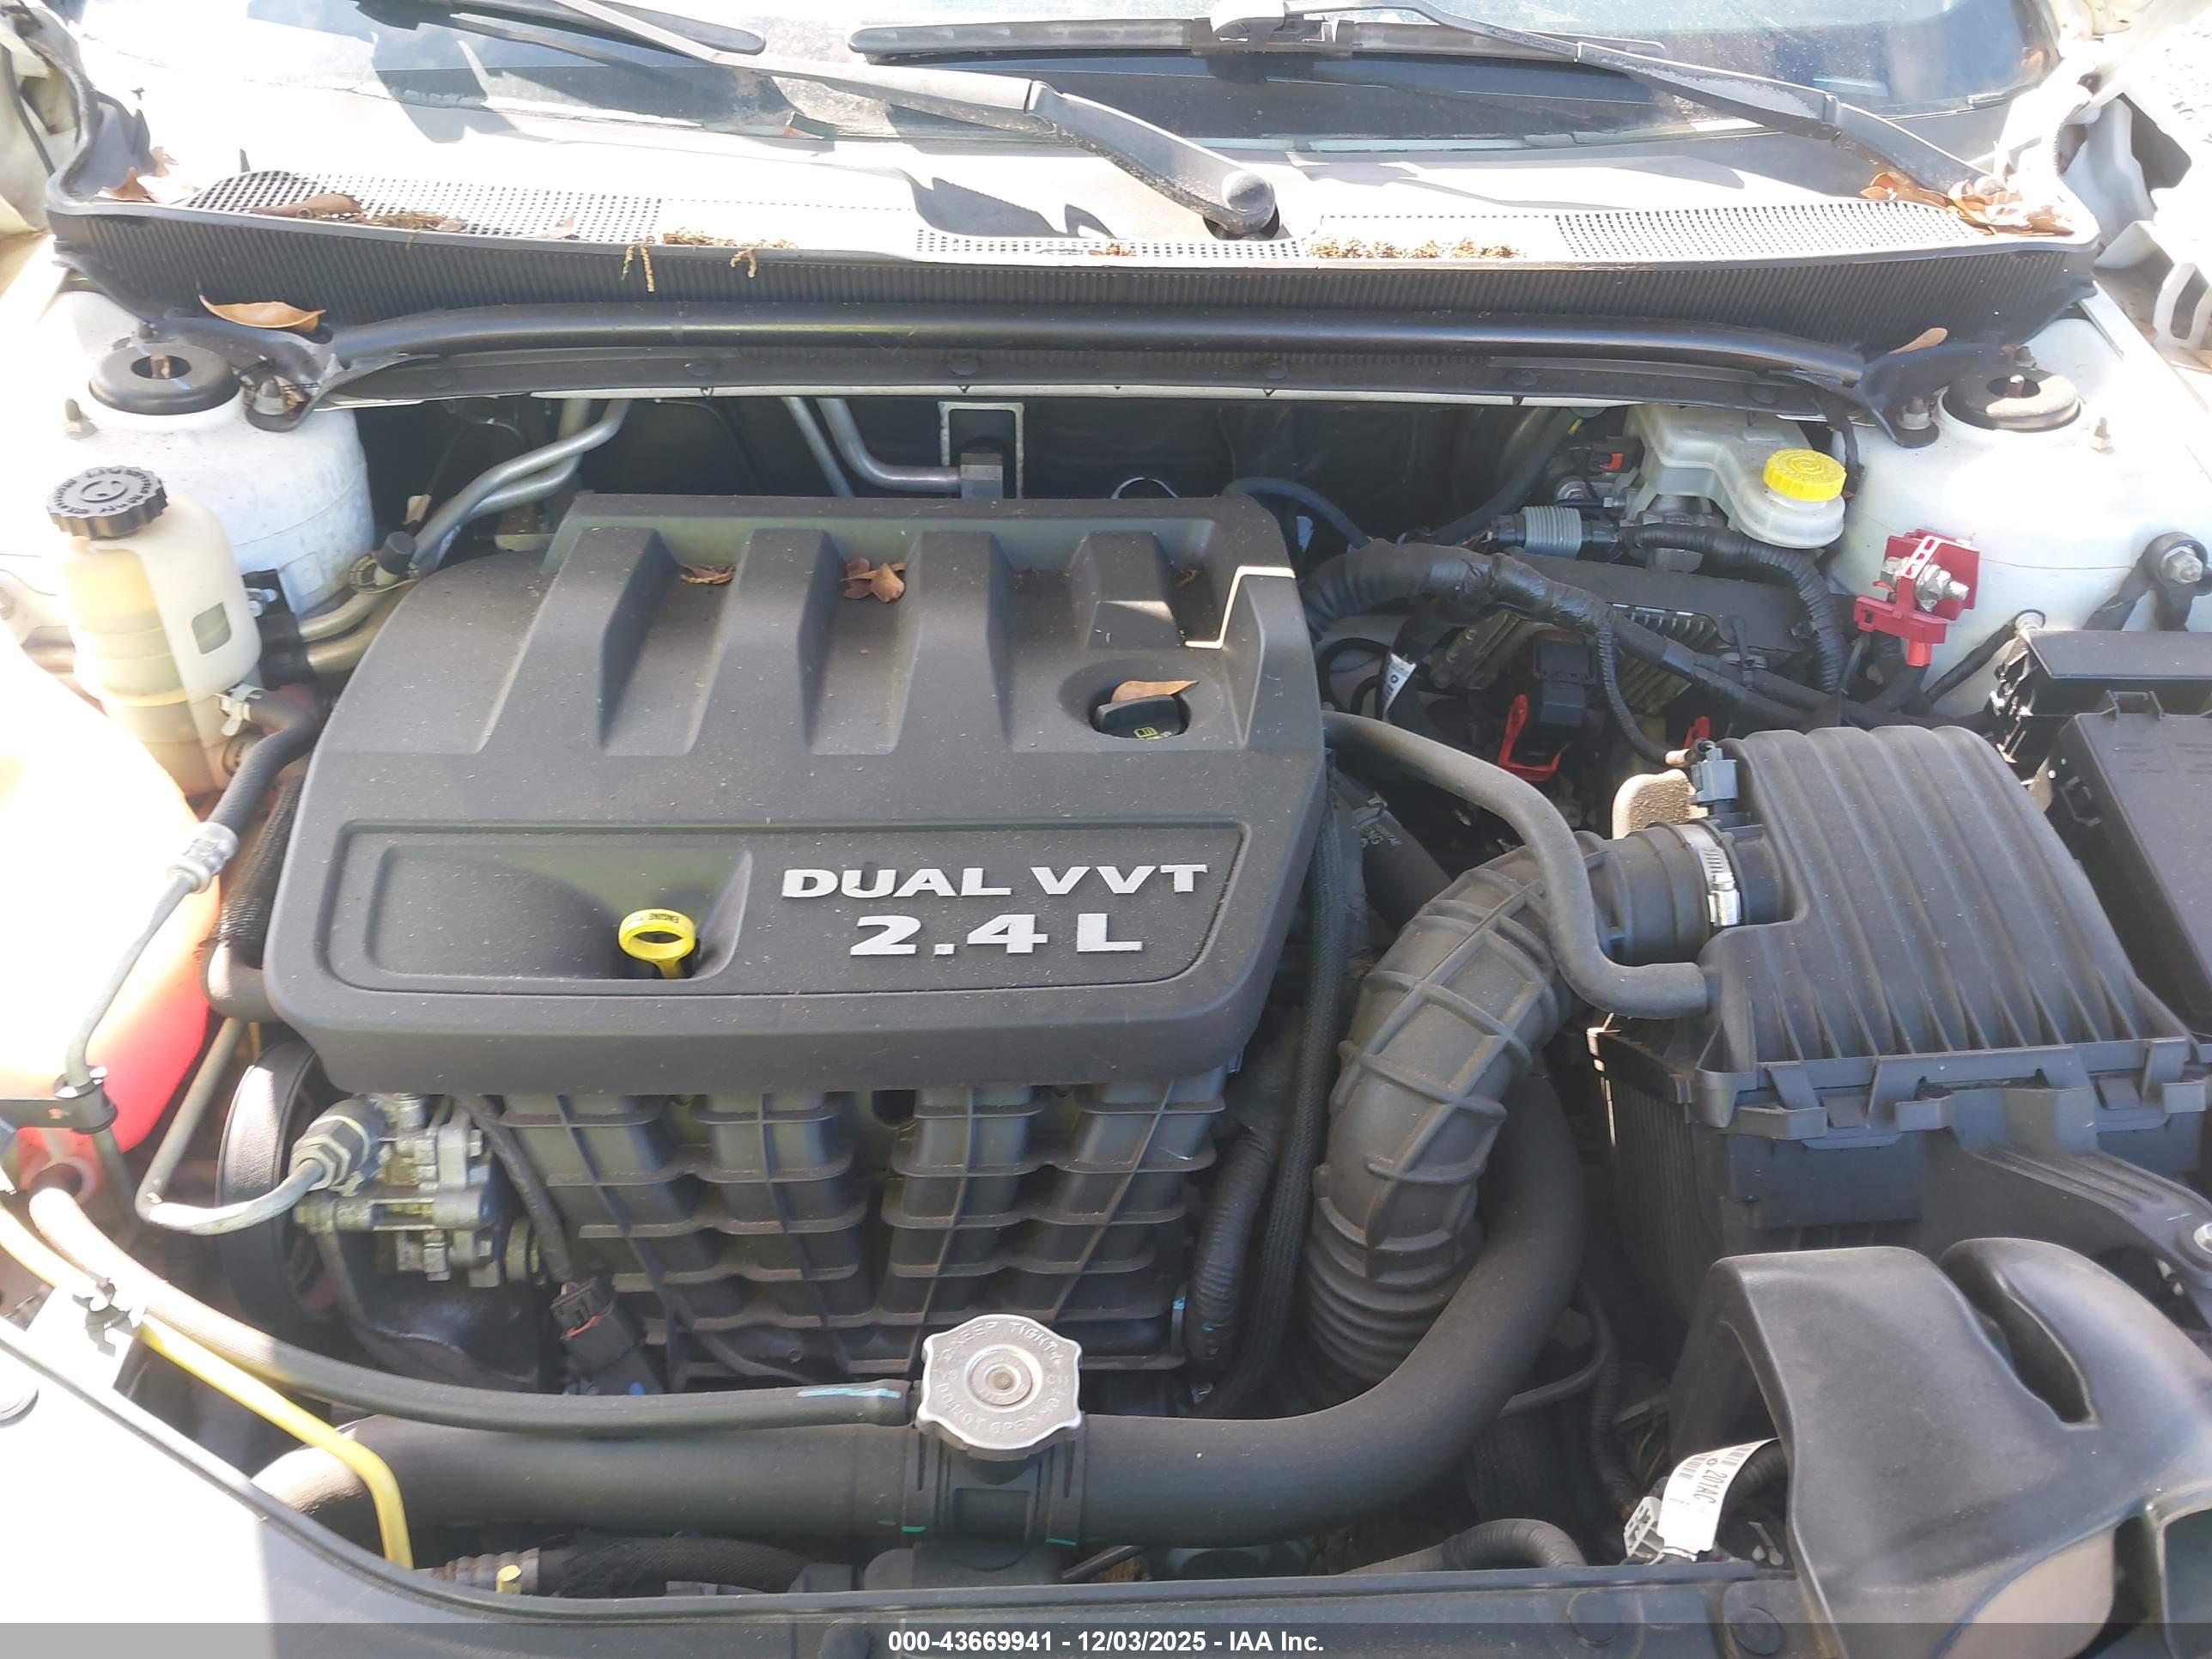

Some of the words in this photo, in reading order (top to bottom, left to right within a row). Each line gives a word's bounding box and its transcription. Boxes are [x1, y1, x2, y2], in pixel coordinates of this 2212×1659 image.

[782, 867, 1012, 898] DUAL
[1031, 864, 1208, 895] VVT
[950, 1321, 998, 1346] KEEP
[1010, 1321, 1059, 1352] TIGHT
[1692, 1469, 1729, 1504] 201AC
